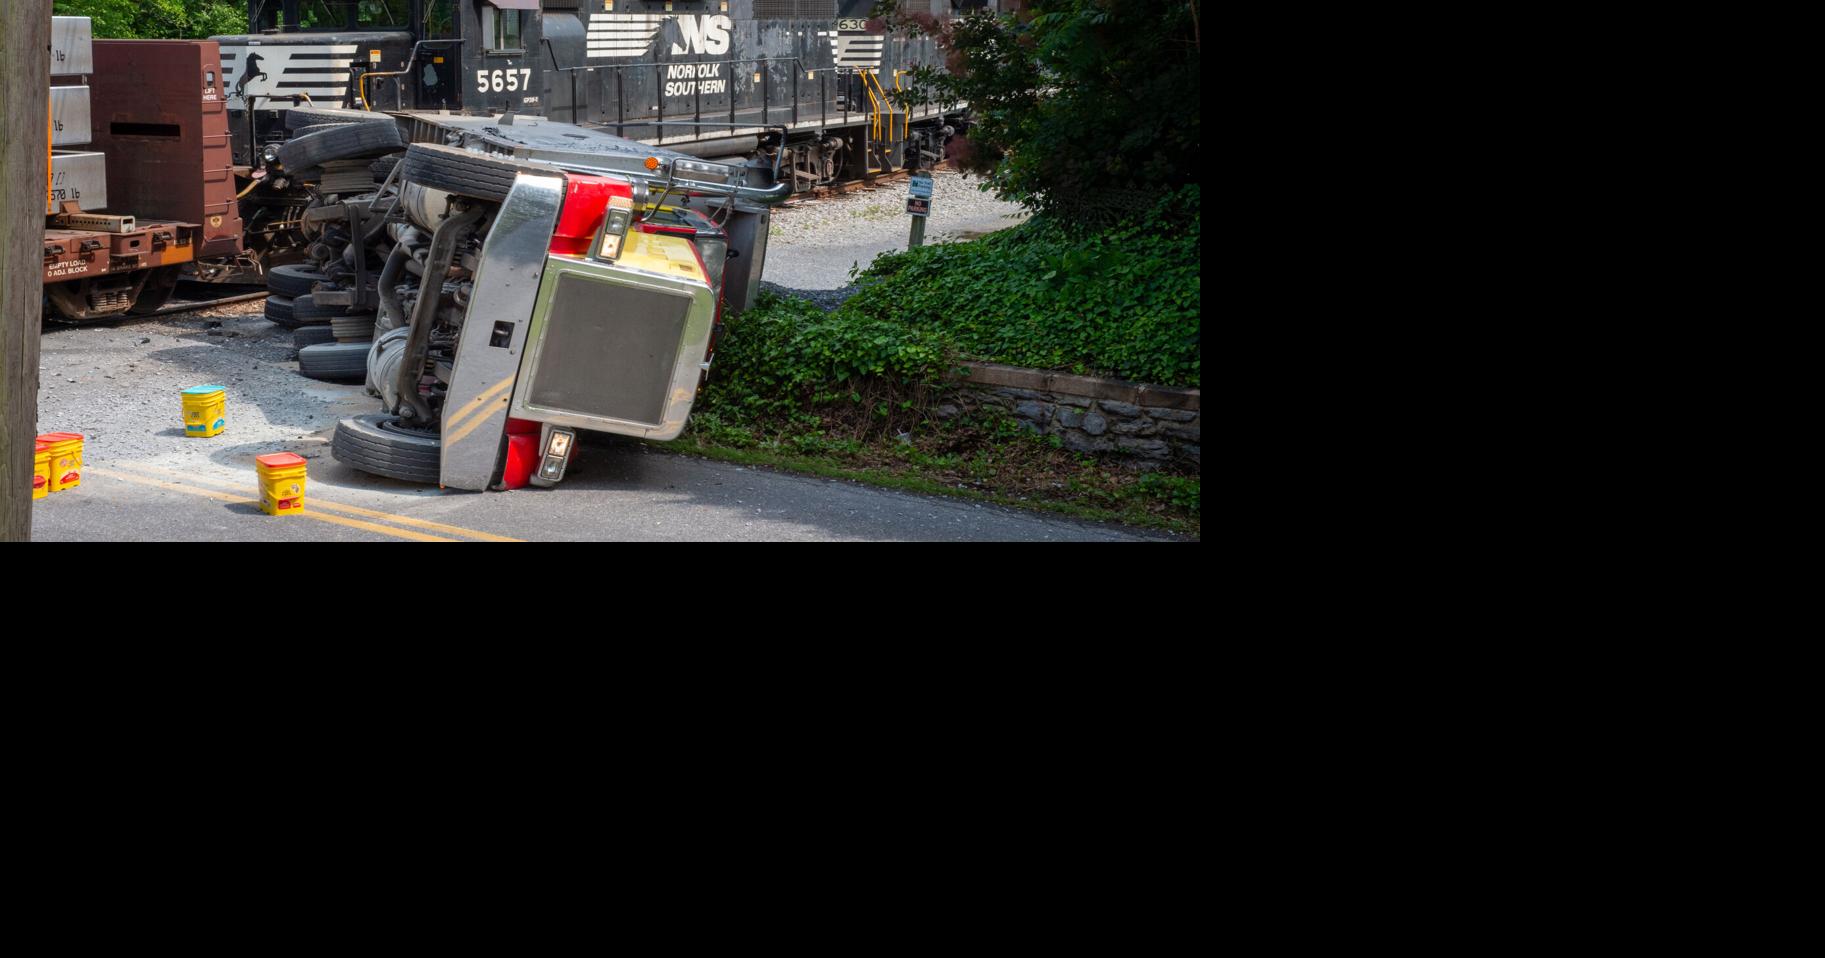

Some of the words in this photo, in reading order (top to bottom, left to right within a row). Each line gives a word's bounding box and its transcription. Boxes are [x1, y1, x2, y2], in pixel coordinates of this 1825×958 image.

[477, 68, 531, 93] 5657
[664, 79, 726, 96] SOUTHERN
[67, 265, 88, 274] BLOCK
[69, 259, 86, 267] LOAD
